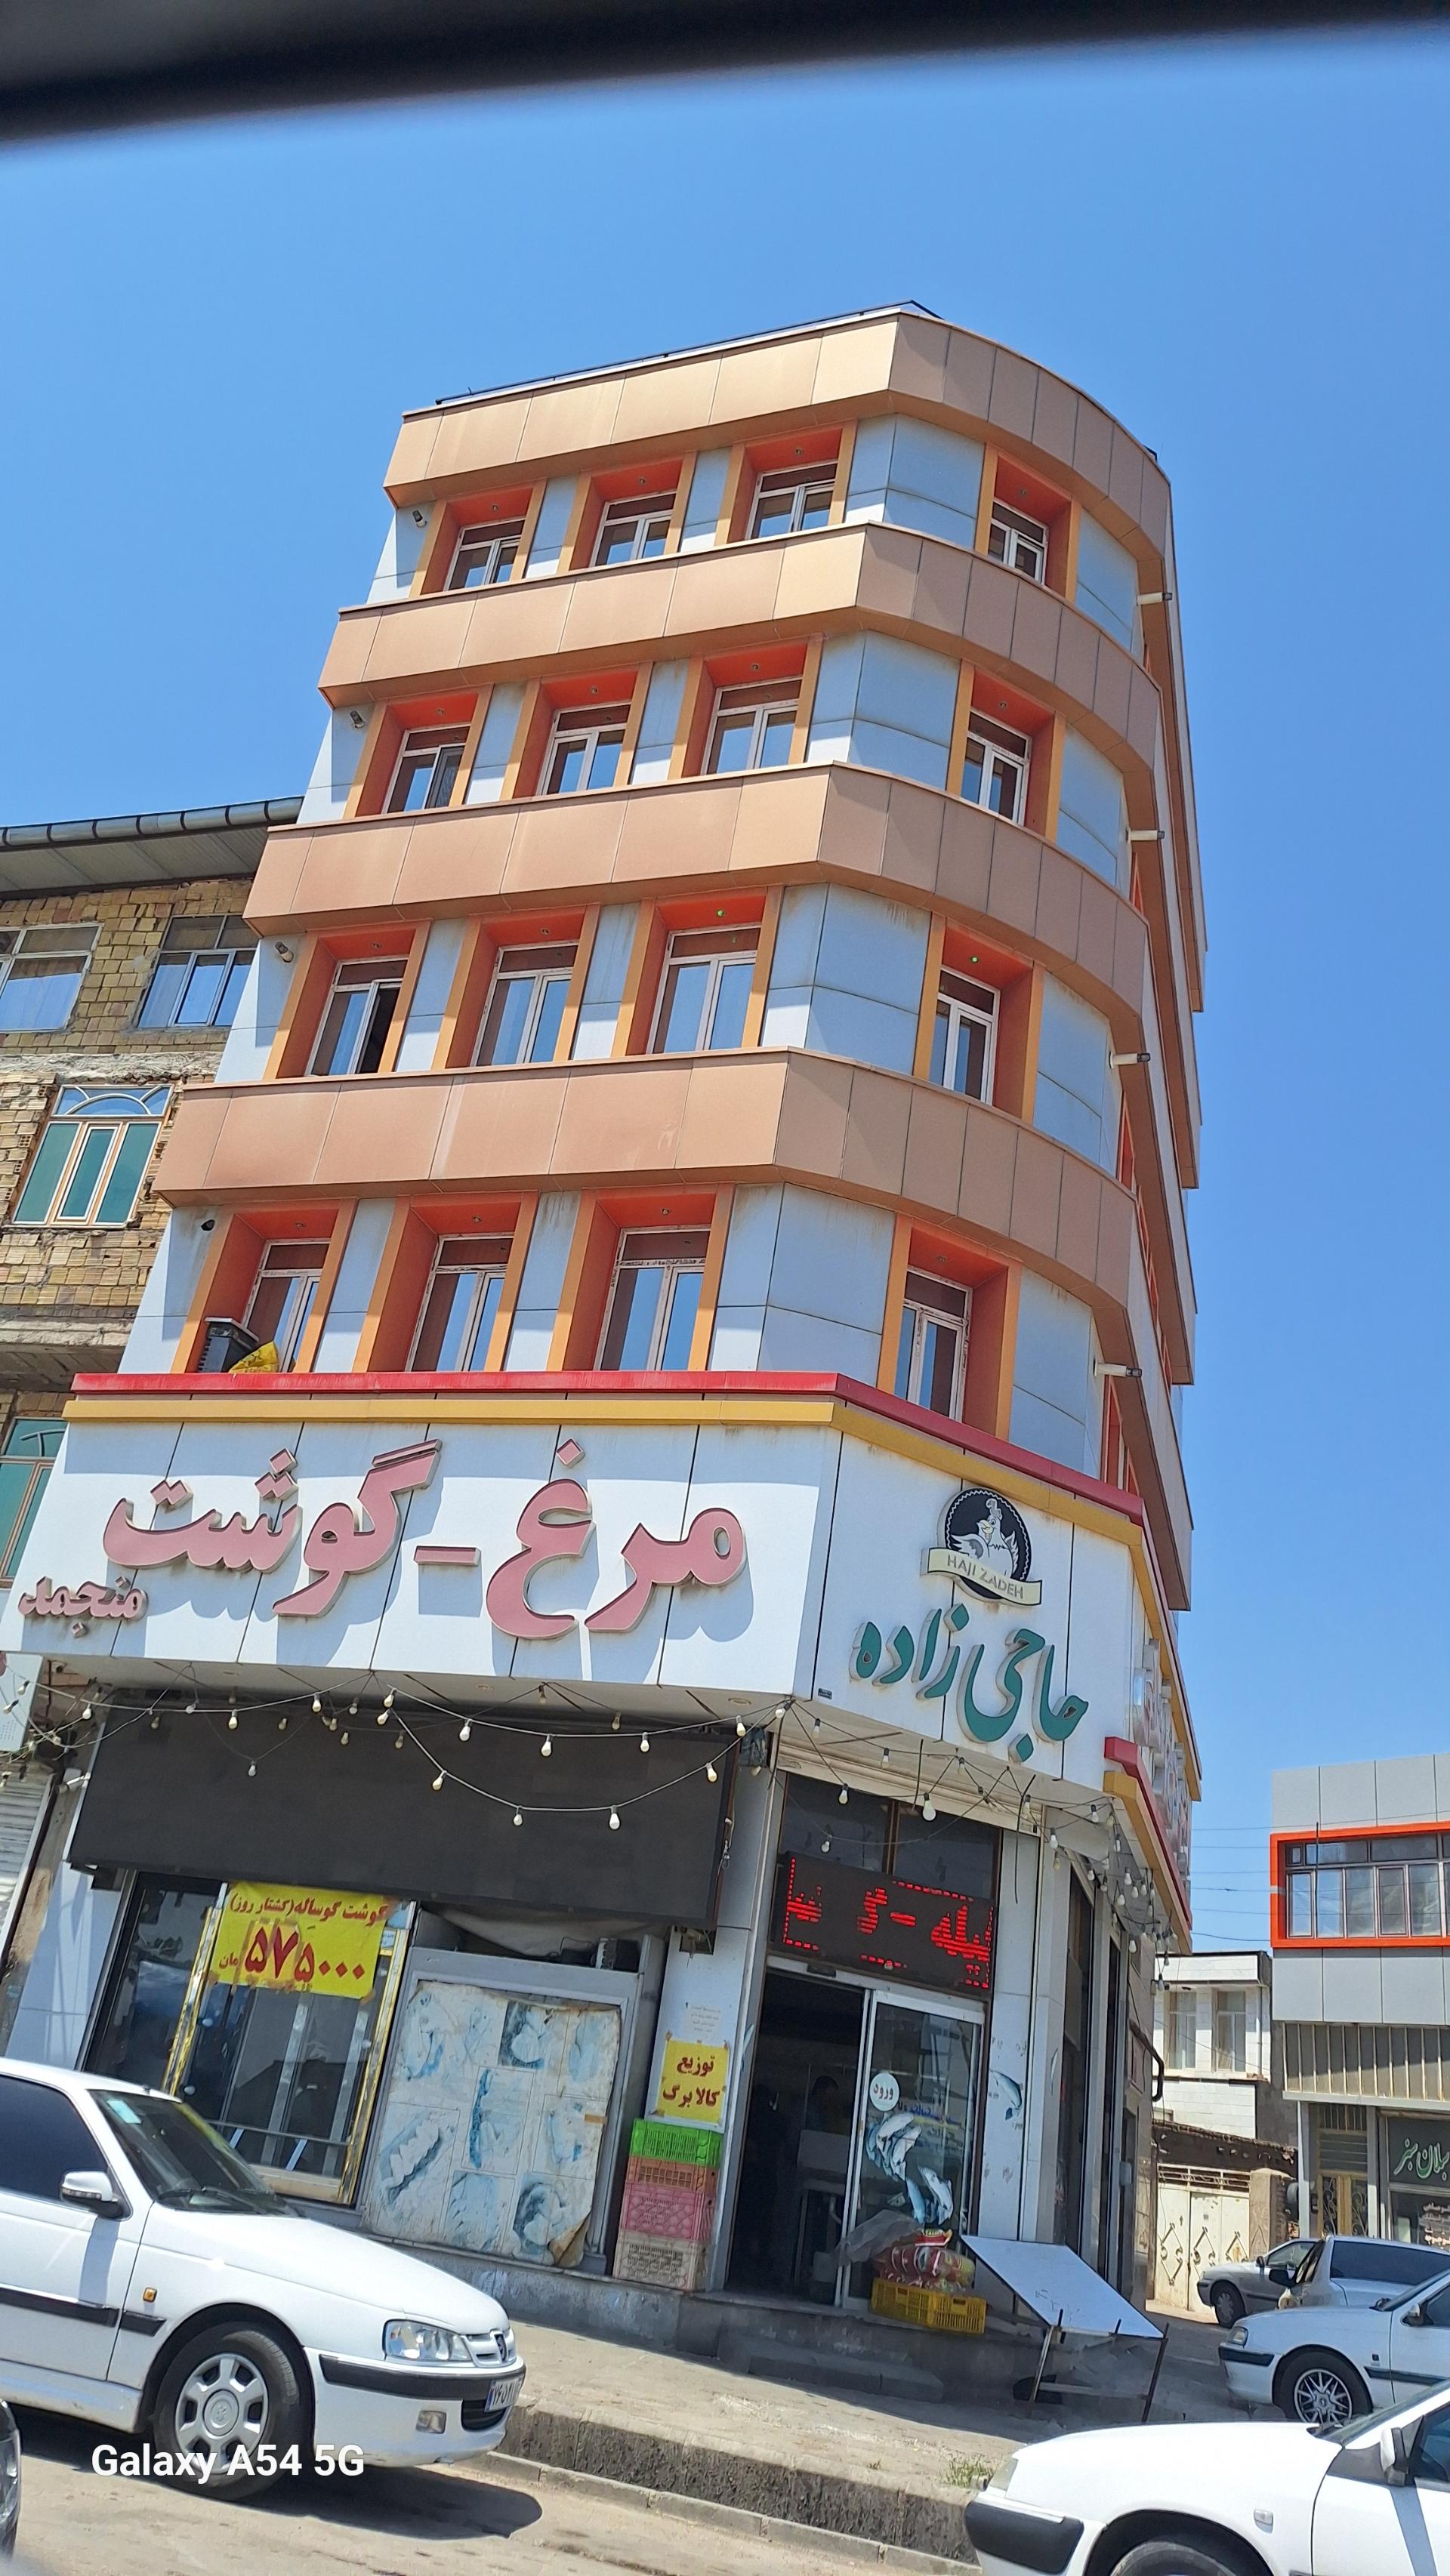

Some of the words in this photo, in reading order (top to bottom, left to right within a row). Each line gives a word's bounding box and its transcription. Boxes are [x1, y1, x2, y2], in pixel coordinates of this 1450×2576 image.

[103, 1439, 443, 1618] گوشت
[486, 1438, 748, 1641] مرغ
[17, 1575, 149, 1638] منجمد
[946, 1554, 976, 1576] HAJI
[979, 1568, 1024, 1600] ZADEH
[850, 1602, 970, 1699] زاده
[676, 2054, 716, 2078] توزیع
